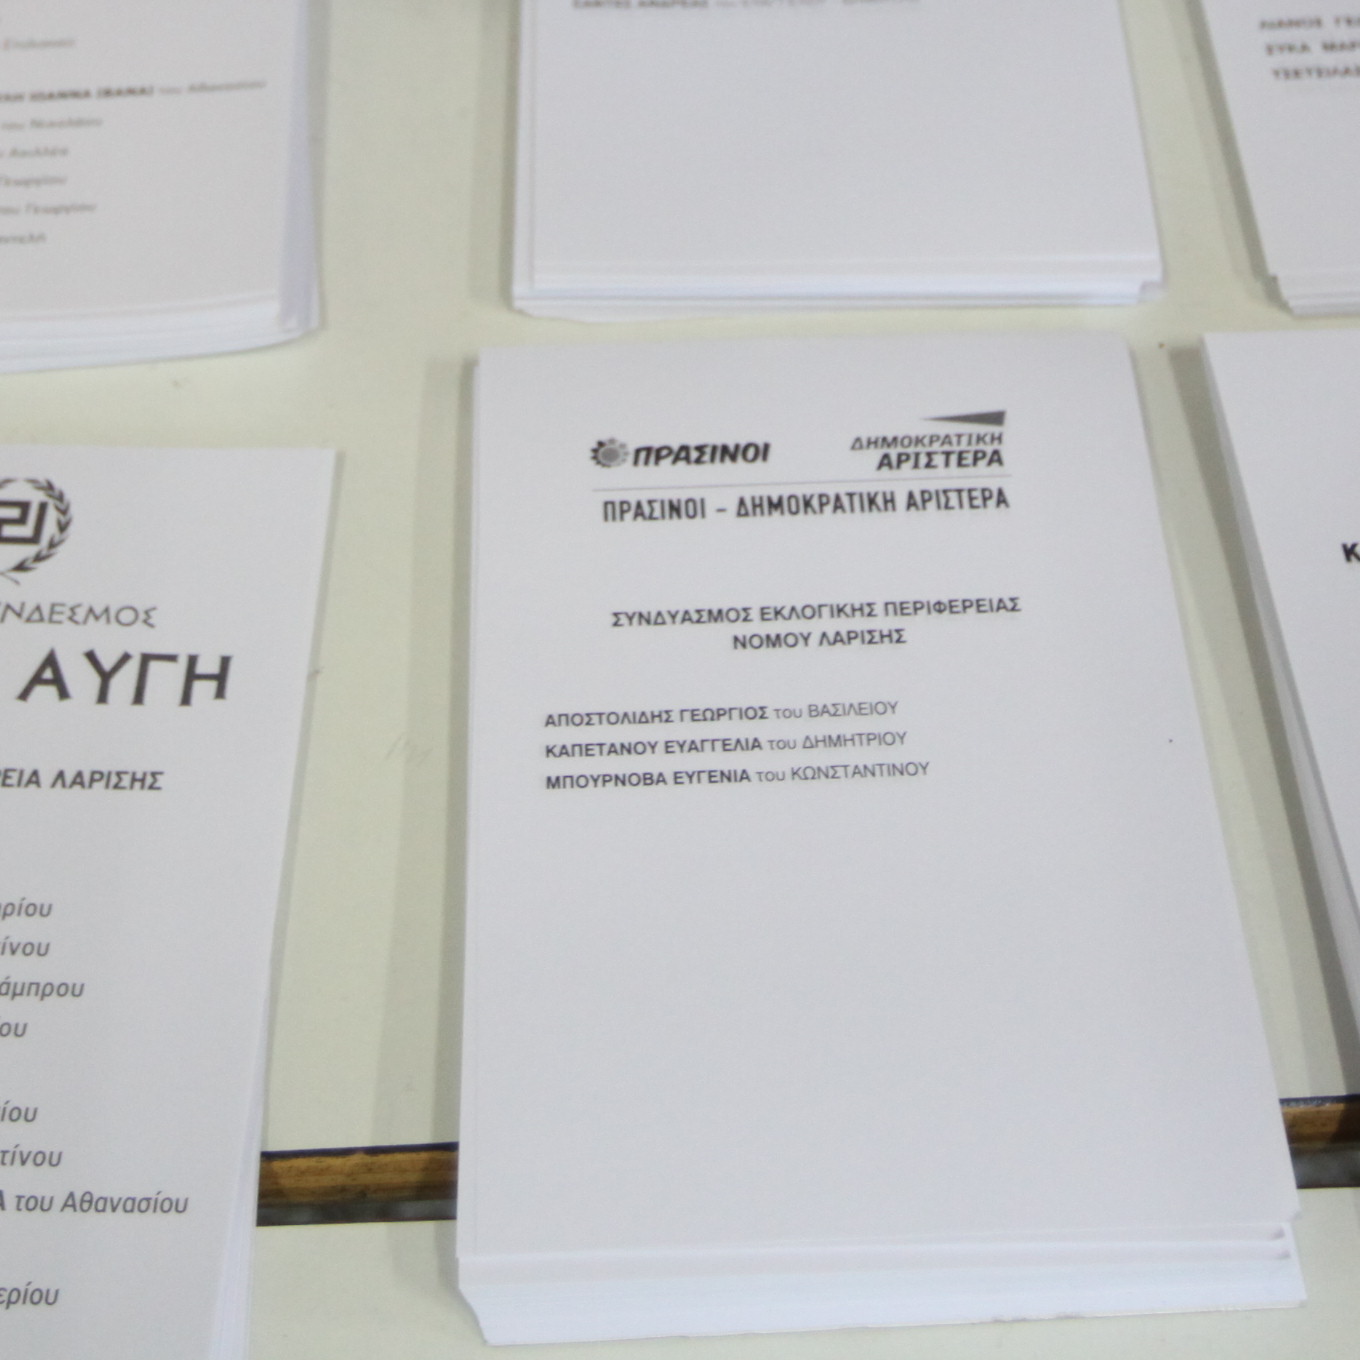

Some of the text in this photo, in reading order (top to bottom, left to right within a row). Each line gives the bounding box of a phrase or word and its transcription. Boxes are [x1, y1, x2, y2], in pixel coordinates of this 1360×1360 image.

[633, 443, 770, 466] ΠΡΑΣΙΝΟΙ
[851, 433, 1002, 450] ΔΗΜΟΚΡΑΤΙΚΗ
[877, 449, 1003, 470] ΑΡΙΣΤΕΡΑ
[603, 498, 705, 522] ΠΡΑΣΙΝΟΙ
[737, 491, 896, 517] ΔΗΜΟΚΡΑΤΙΚΗ
[906, 487, 1009, 511] ΑΡΙΣΤΕΡΑ
[612, 597, 1021, 627] ΣΥΝΔΥΑΣΜΟΣ ΕΚΛΟΓΙΚΗΣ ΠΕΡΙΦΕΡΕΙΑΣ
[733, 629, 906, 649] ΝΟΜΟΥ ΛΑΡΙΣΗΣ
[17, 649, 231, 706] ΑΥΓΗ
[545, 701, 898, 727] ΑΠΟΣΤΟΛΙΔΗΣ ΓΕΩΡΓΙΟΣ του ΒΑΣΙΛΕΙΟΥ
[546, 732, 906, 758] ΚΑΠΕΤΑΝΟΥ ΕΥΑΓΓΕΛΙΑ του ΔΗΜΗΤΡΙΟΥ
[51, 770, 164, 790] ΛΑΡΙΣΗΣ
[546, 762, 929, 789] ΜΠΟΥΡΝΟΒΑ ΕΥΓΕΝΙΑ του ΚΩΝΣΤΑΝΤΙΝΟΥ
